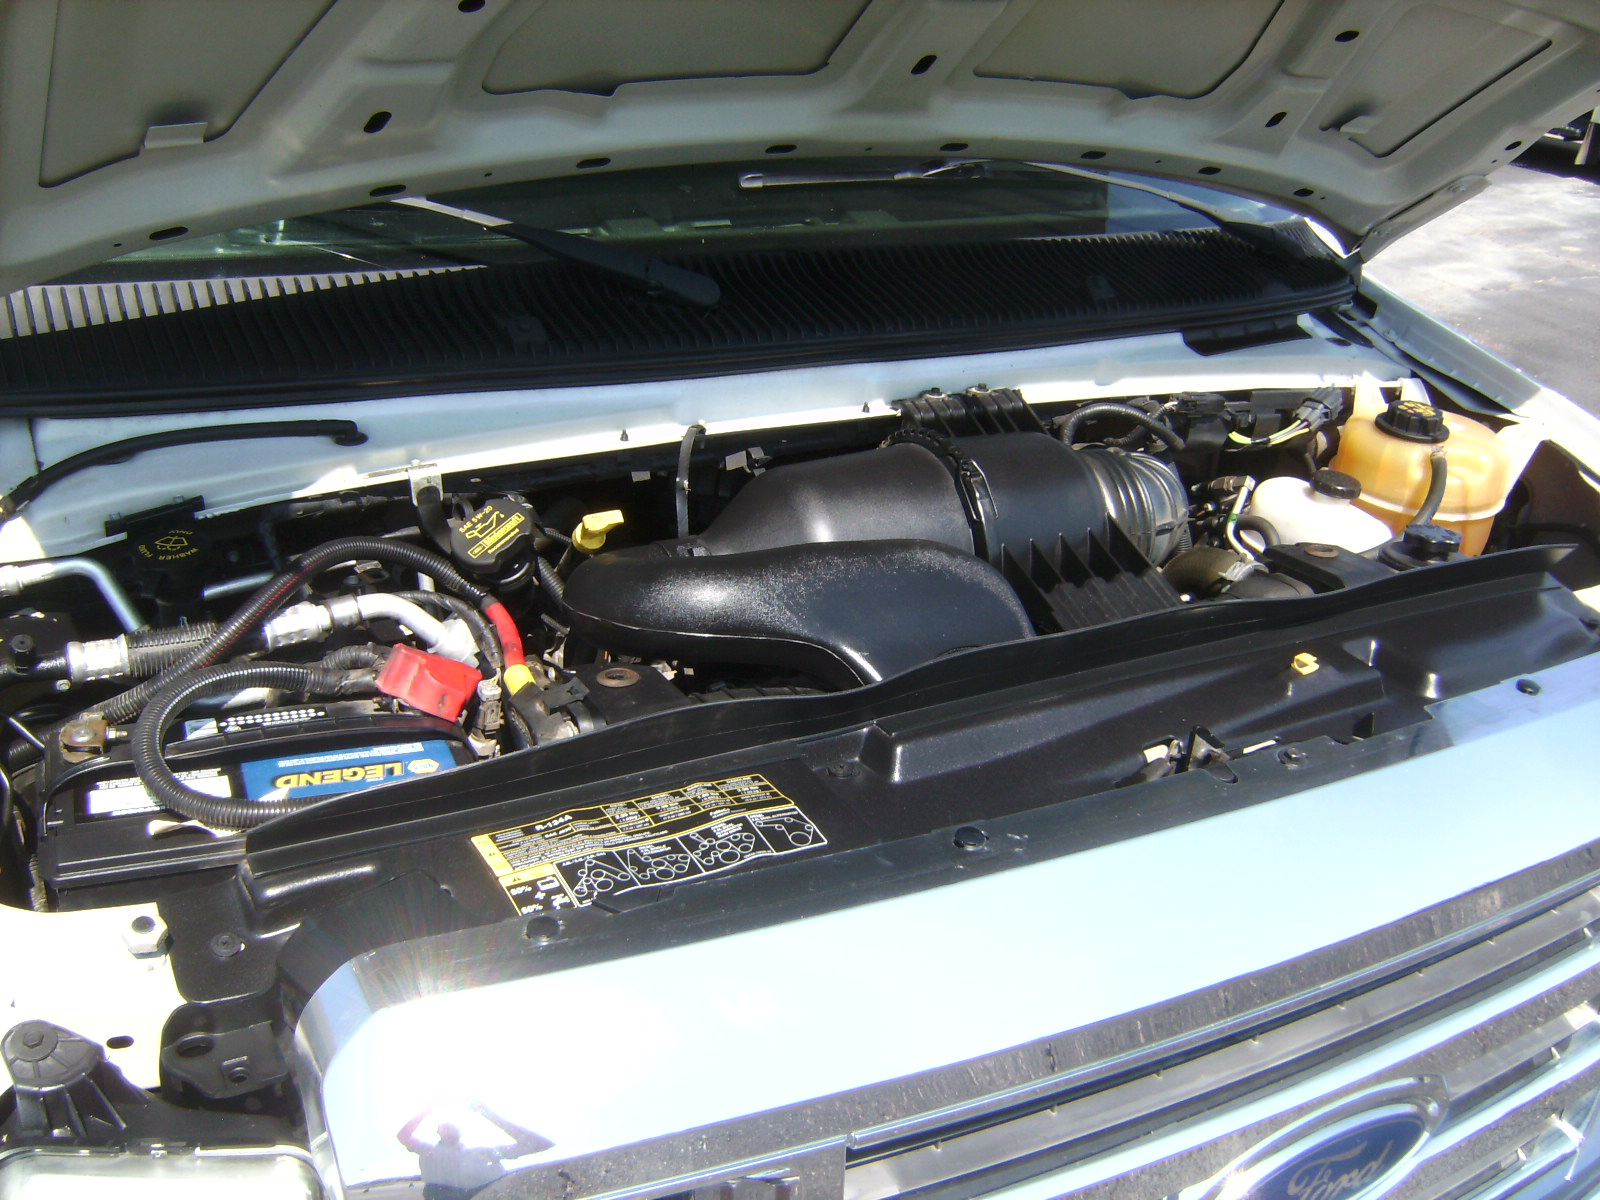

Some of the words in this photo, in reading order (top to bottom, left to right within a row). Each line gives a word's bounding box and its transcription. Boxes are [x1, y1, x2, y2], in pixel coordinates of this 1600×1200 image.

[459, 521, 473, 534] SAE
[472, 505, 493, 523] 5W-20
[483, 514, 523, 548] Motorcraft
[158, 547, 200, 561] WASHER
[274, 761, 403, 789] LEGEND
[534, 814, 573, 832] R-134A
[1287, 1139, 1394, 1200] Ford
